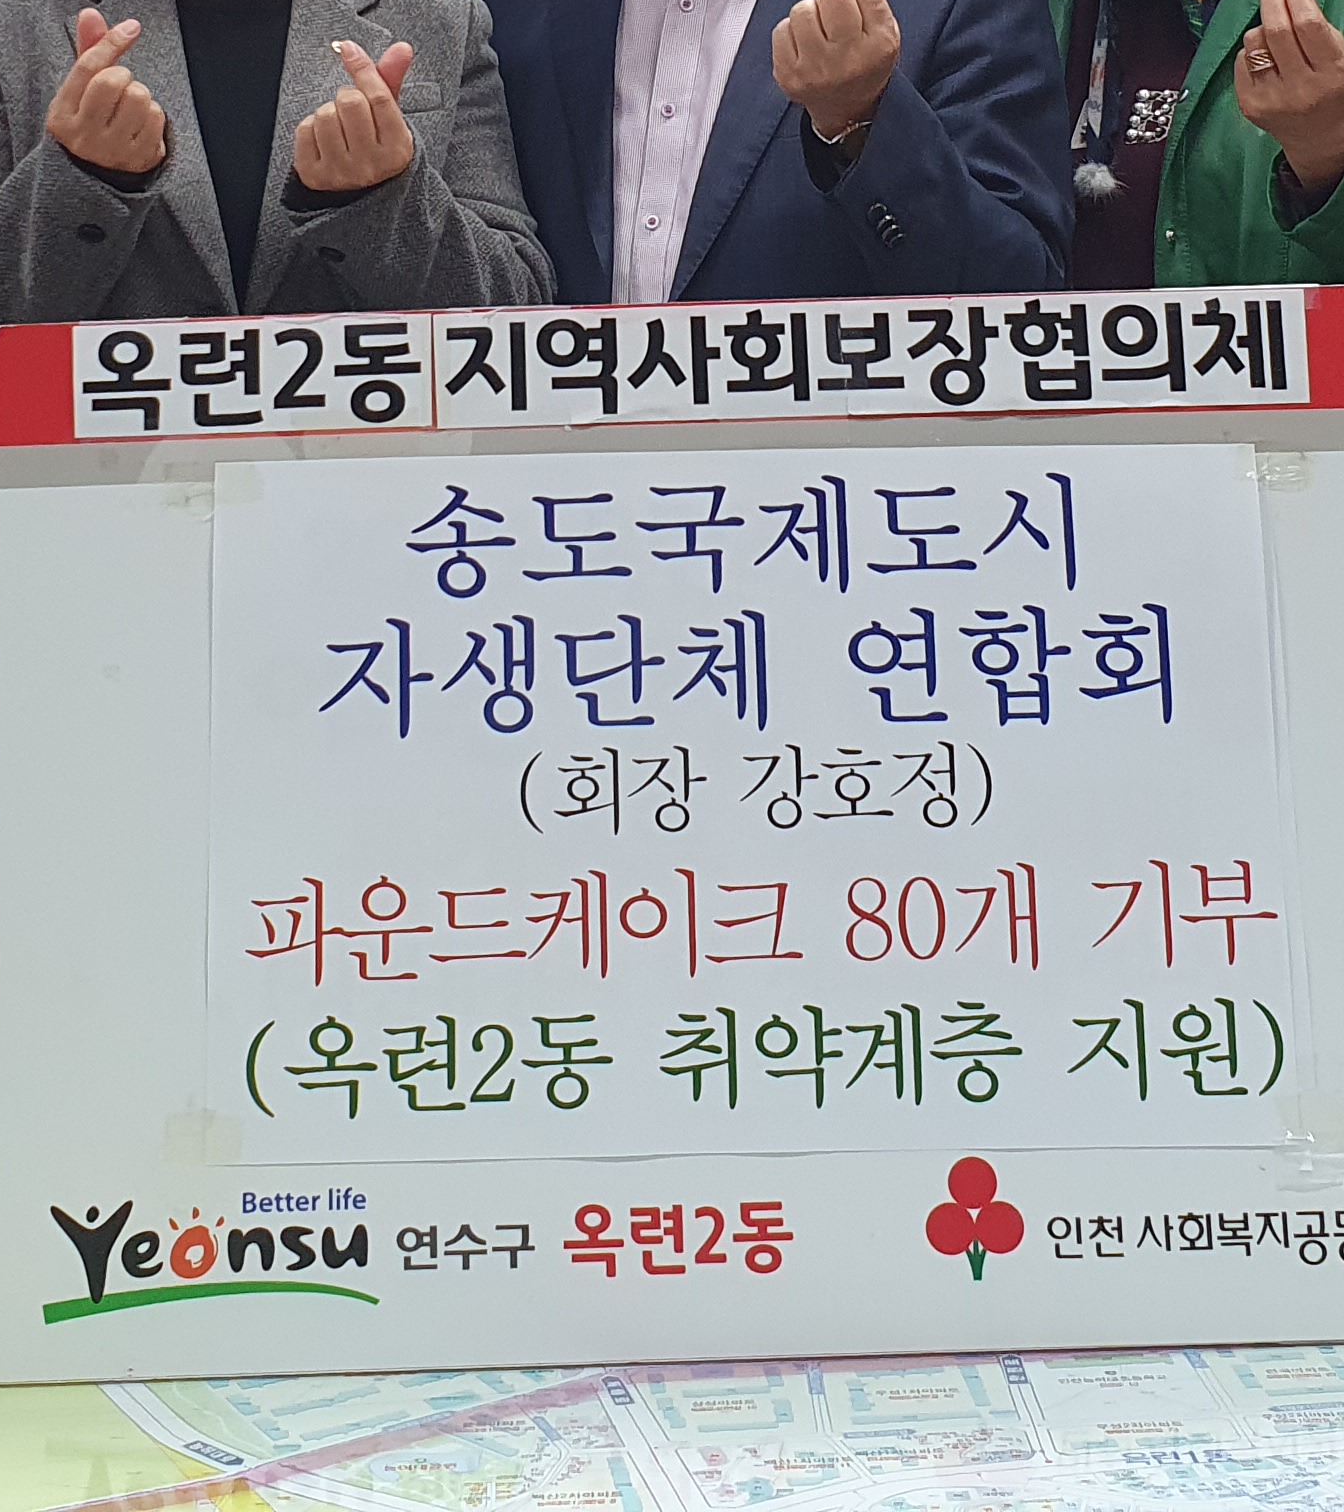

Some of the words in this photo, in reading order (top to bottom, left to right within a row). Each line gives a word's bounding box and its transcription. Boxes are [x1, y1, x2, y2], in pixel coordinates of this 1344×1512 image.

[82, 322, 423, 430] 옥련2동
[444, 297, 1288, 414] 지역사회보장협의체
[406, 473, 1076, 598] 송도국제도시
[319, 610, 767, 739] 자생단체
[848, 603, 1172, 726] 연합회
[521, 746, 707, 835] (회장
[740, 741, 992, 829] 강호정)
[245, 868, 803, 987] 파운드케이크
[846, 862, 1038, 970] 80개
[1091, 860, 1278, 968] 기부
[246, 1015, 613, 1119] (옥련2동
[660, 1001, 1022, 1109] 취약계층
[1067, 998, 1283, 1101] 지원)
[50, 1200, 370, 1304] Yeonsu
[241, 1190, 321, 1215] Better
[327, 1186, 368, 1212] life
[396, 1224, 535, 1271] 연수구
[563, 1202, 794, 1277] 옥련2동
[1047, 1216, 1124, 1259] 인천
